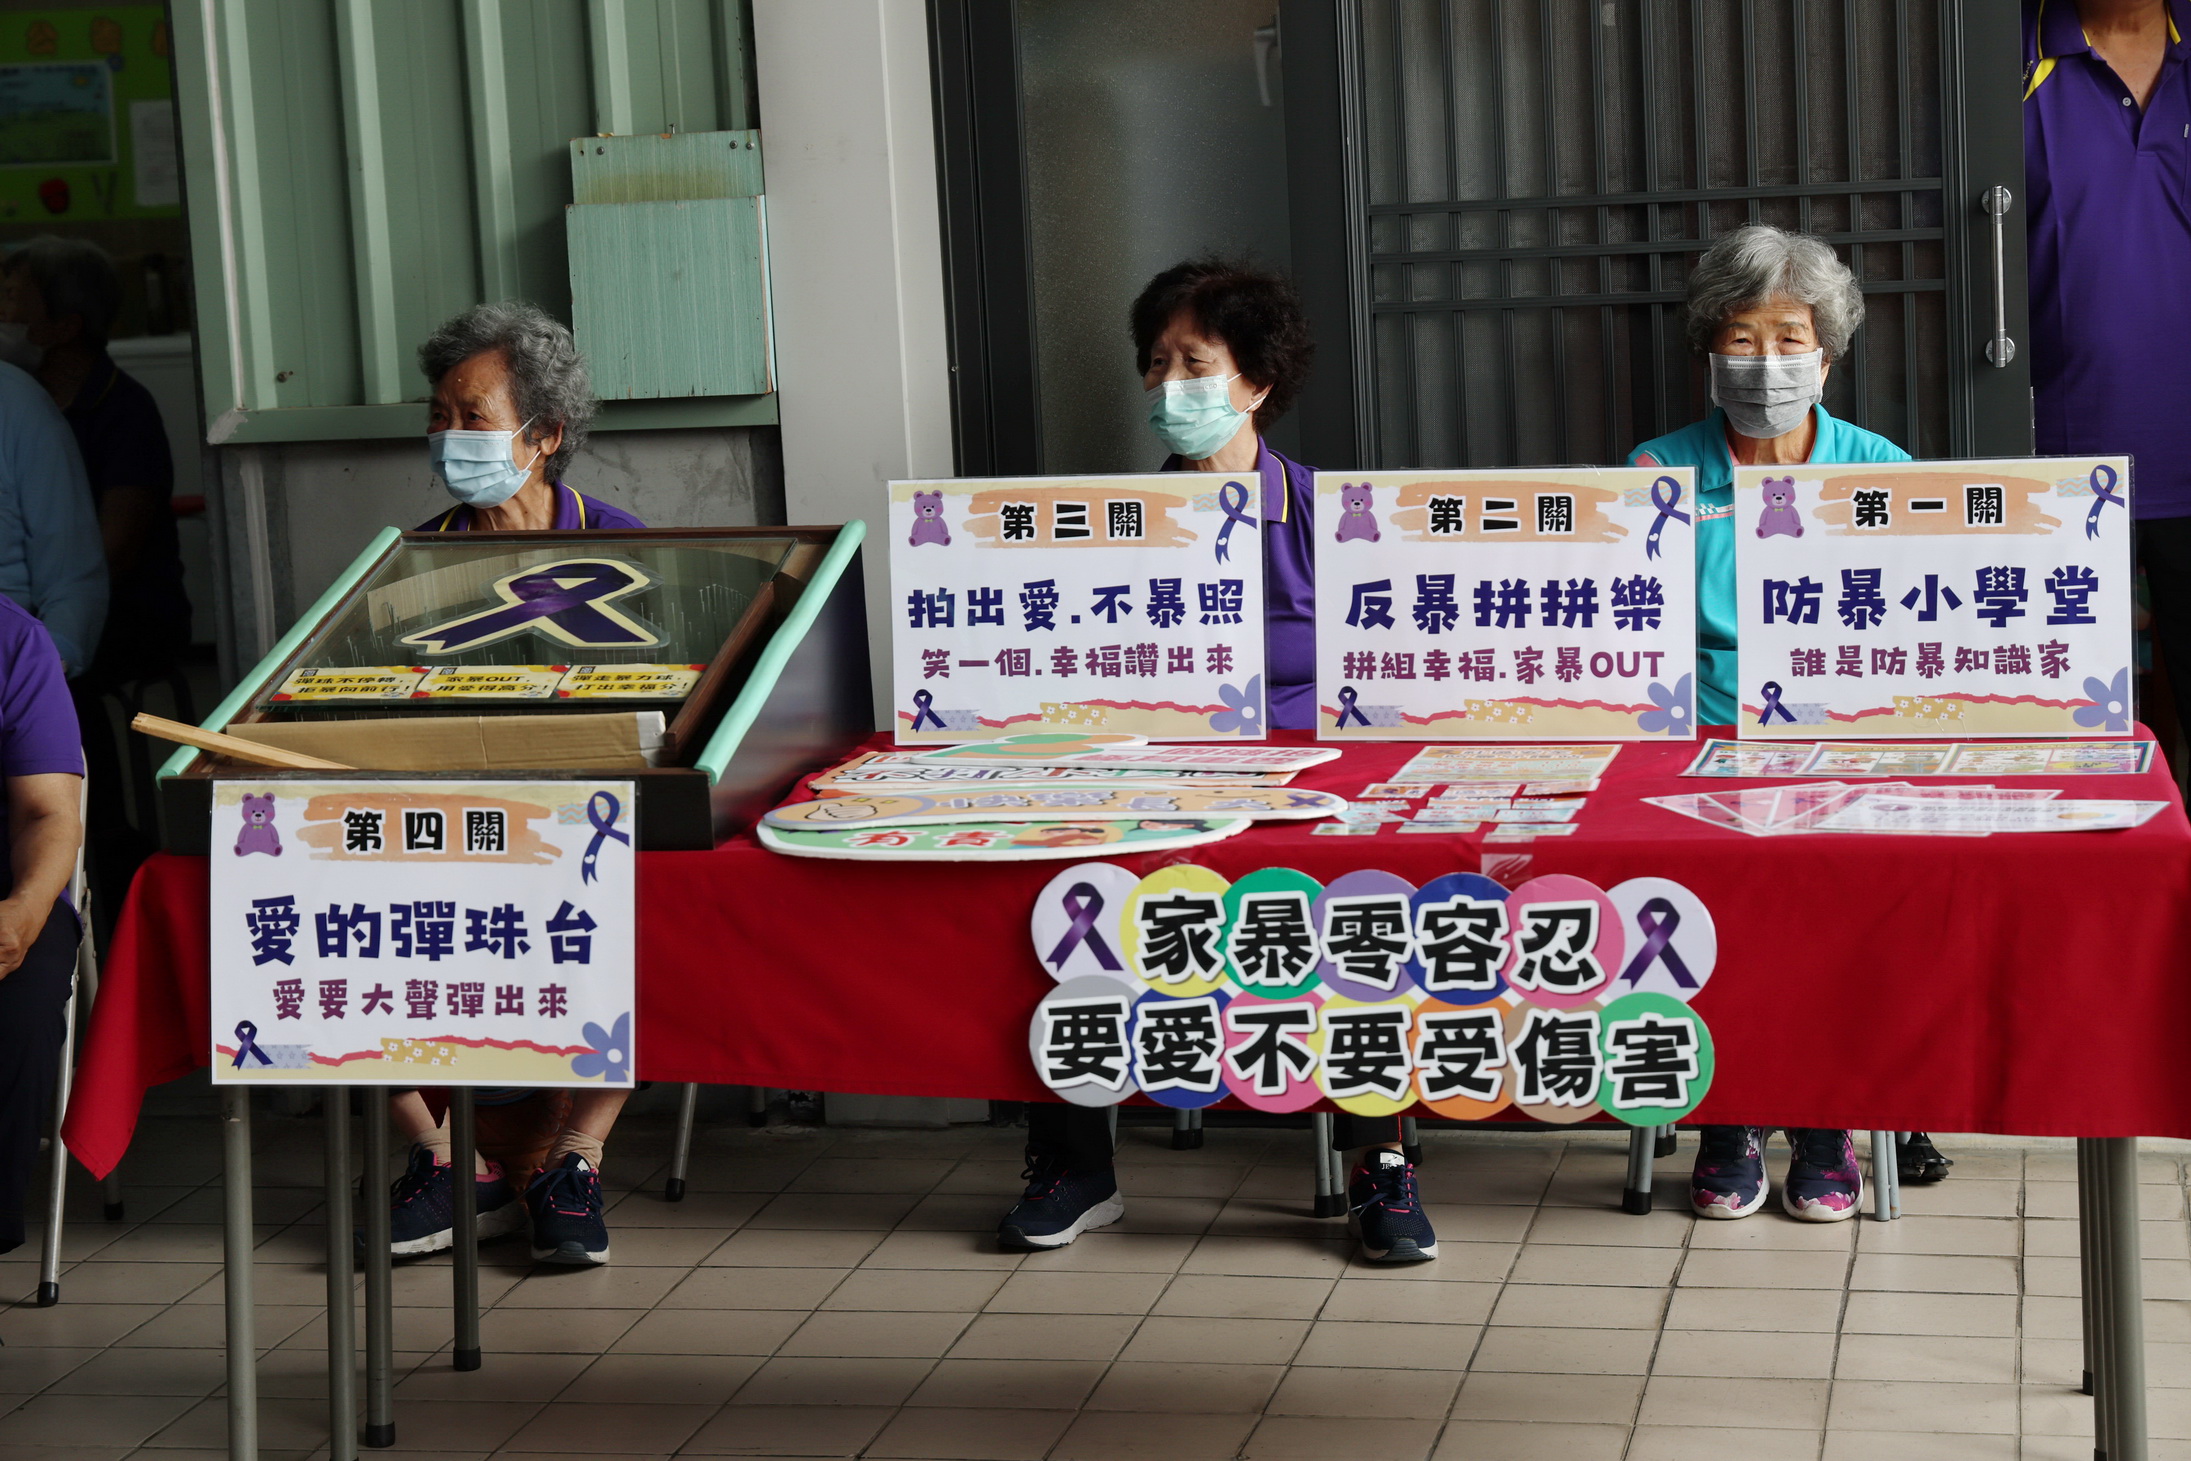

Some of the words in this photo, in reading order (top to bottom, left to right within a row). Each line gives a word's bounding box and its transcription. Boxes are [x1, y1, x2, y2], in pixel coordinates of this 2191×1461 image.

[1001, 502, 1143, 540] 第三關
[1429, 496, 1573, 534] 第二關
[1853, 487, 2003, 528] 第一關
[1345, 574, 1665, 634] 反暴拼拼樂
[1763, 565, 2099, 630] 防暴小學堂
[1790, 638, 2071, 679] 誰是防暴知識家
[936, 791, 1275, 811] 快樂長大
[344, 811, 504, 852] 第四關
[245, 895, 598, 967] 愛的彈珠台
[1138, 892, 1599, 989] 家暴零容忍
[273, 978, 568, 1021] 愛要大聲彈出來
[1044, 999, 1694, 1103] 要愛不要受傷害
